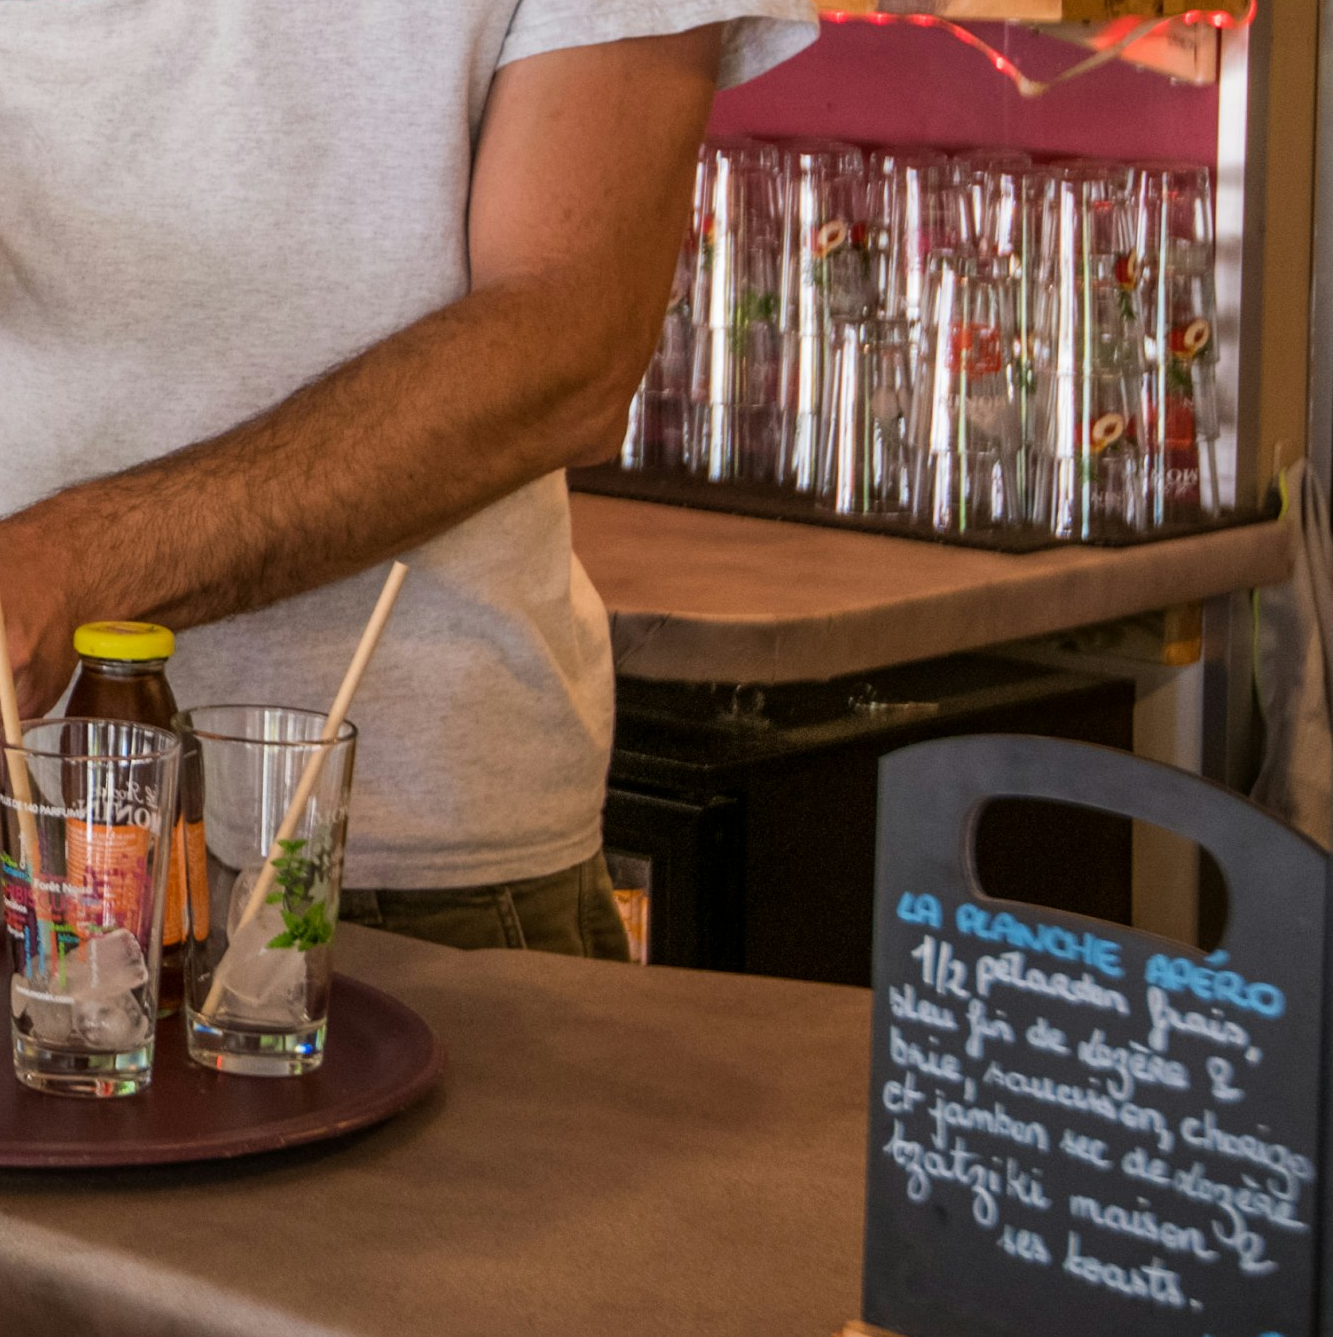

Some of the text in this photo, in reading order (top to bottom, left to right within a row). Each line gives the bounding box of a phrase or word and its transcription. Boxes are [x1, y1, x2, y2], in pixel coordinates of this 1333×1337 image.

[896, 891, 1286, 1019] LA PLANCHE APÉRO
[1025, 1016, 1072, 1056] de
[1069, 1194, 1220, 1261] maison
